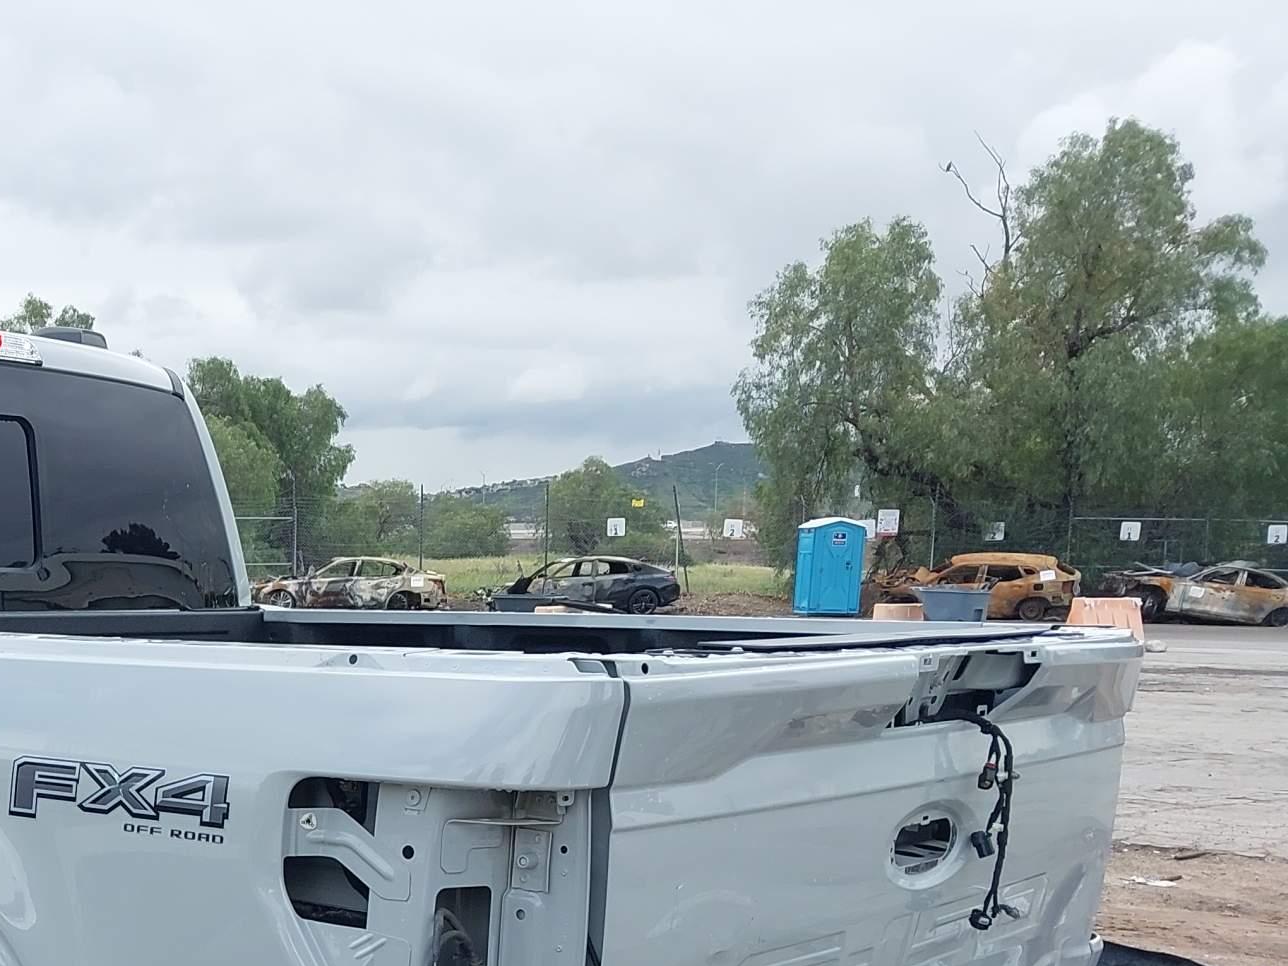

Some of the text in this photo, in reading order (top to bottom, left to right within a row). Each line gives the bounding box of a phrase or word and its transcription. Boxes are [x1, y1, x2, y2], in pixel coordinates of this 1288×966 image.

[9, 754, 230, 829] FX4
[123, 823, 224, 845] OFF ROAD
